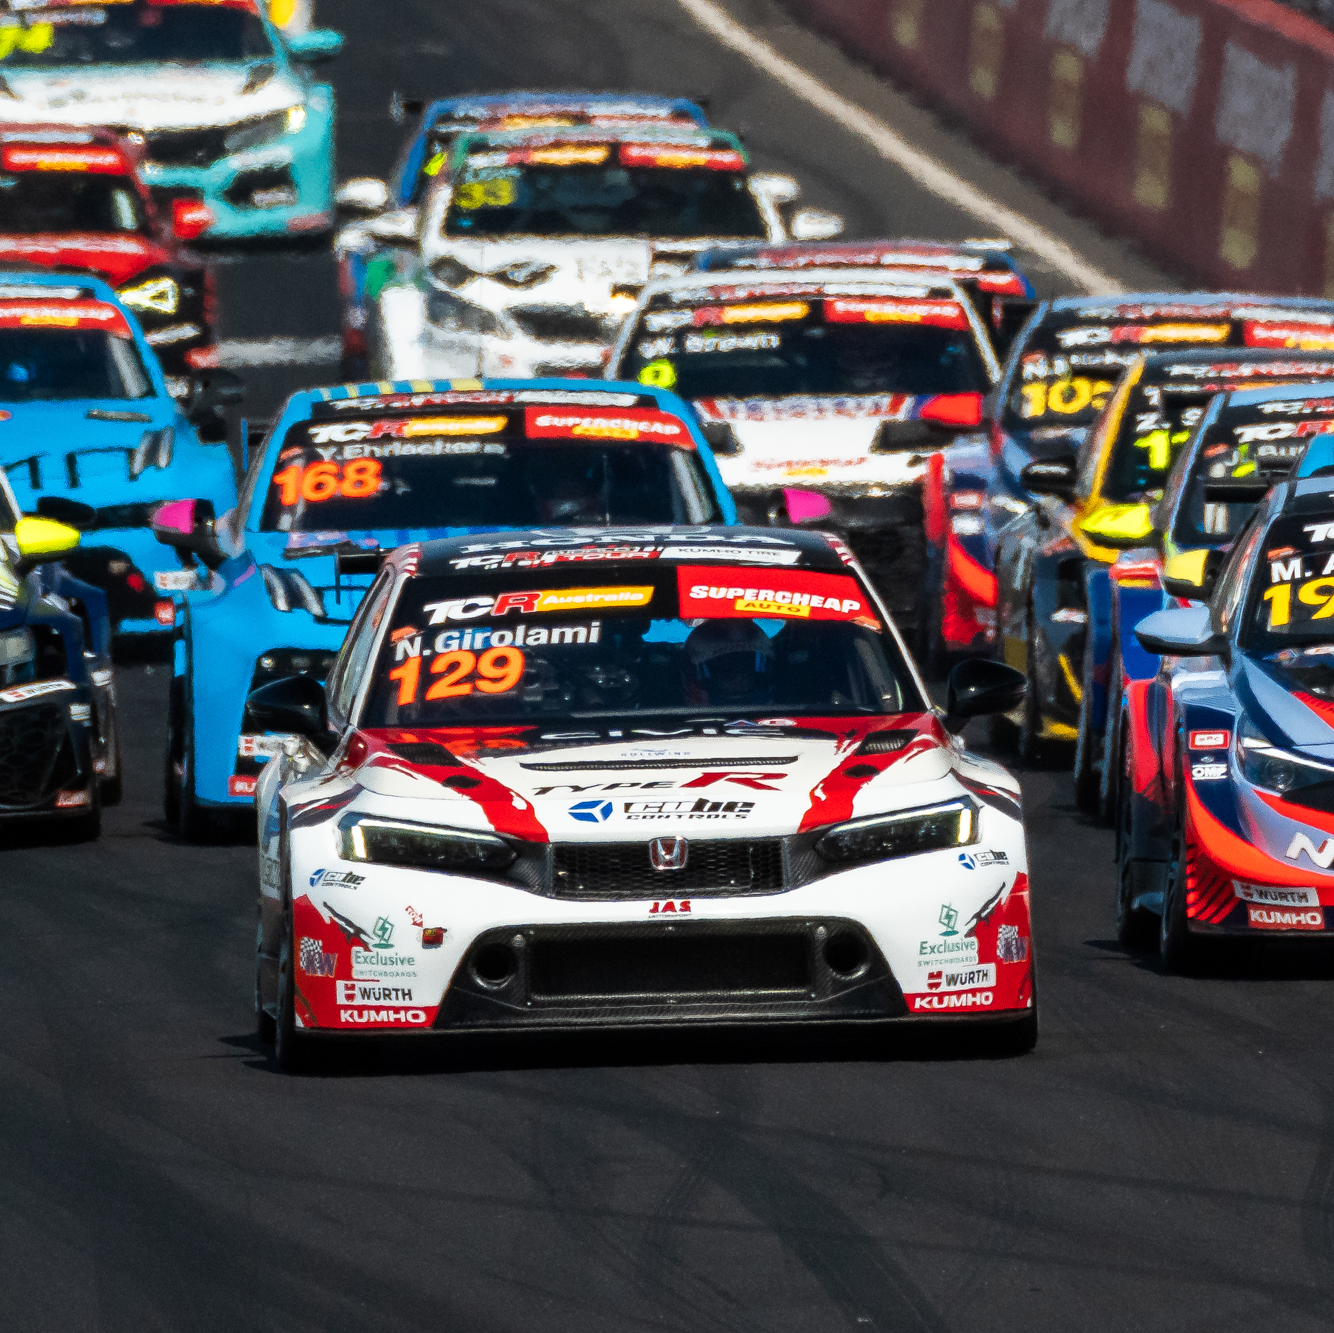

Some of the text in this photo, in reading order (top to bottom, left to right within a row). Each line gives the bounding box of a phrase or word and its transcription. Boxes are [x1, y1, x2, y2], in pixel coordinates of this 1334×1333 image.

[308, 419, 411, 444] TCR
[534, 415, 681, 436] SUPERCHEAP
[273, 458, 384, 506] 168
[460, 533, 796, 555] HONDA
[676, 547, 735, 557] KUMHO
[743, 549, 782, 558] TIRE
[1271, 558, 1313, 583] M.
[423, 590, 645, 626] TCR Australia
[688, 585, 862, 615] SUPERCHEAP
[743, 601, 803, 614] AUTO
[395, 621, 602, 661] N.Girolami
[388, 647, 525, 706] 129
[540, 727, 786, 740] CIVIC
[1192, 766, 1228, 778] OMP
[532, 771, 789, 796] TYPE R
[625, 813, 749, 821] CONTROLS
[1255, 887, 1310, 903] WÜRTH
[649, 900, 692, 914] JAS
[1249, 909, 1322, 926] KUMHO
[918, 938, 977, 956] Exclusive
[354, 950, 415, 966] Exclusive
[945, 969, 990, 987] WÜRTH
[359, 987, 413, 1002] WÜRTH
[914, 991, 994, 1009] KUMHO
[340, 1009, 427, 1024] KUMHO
